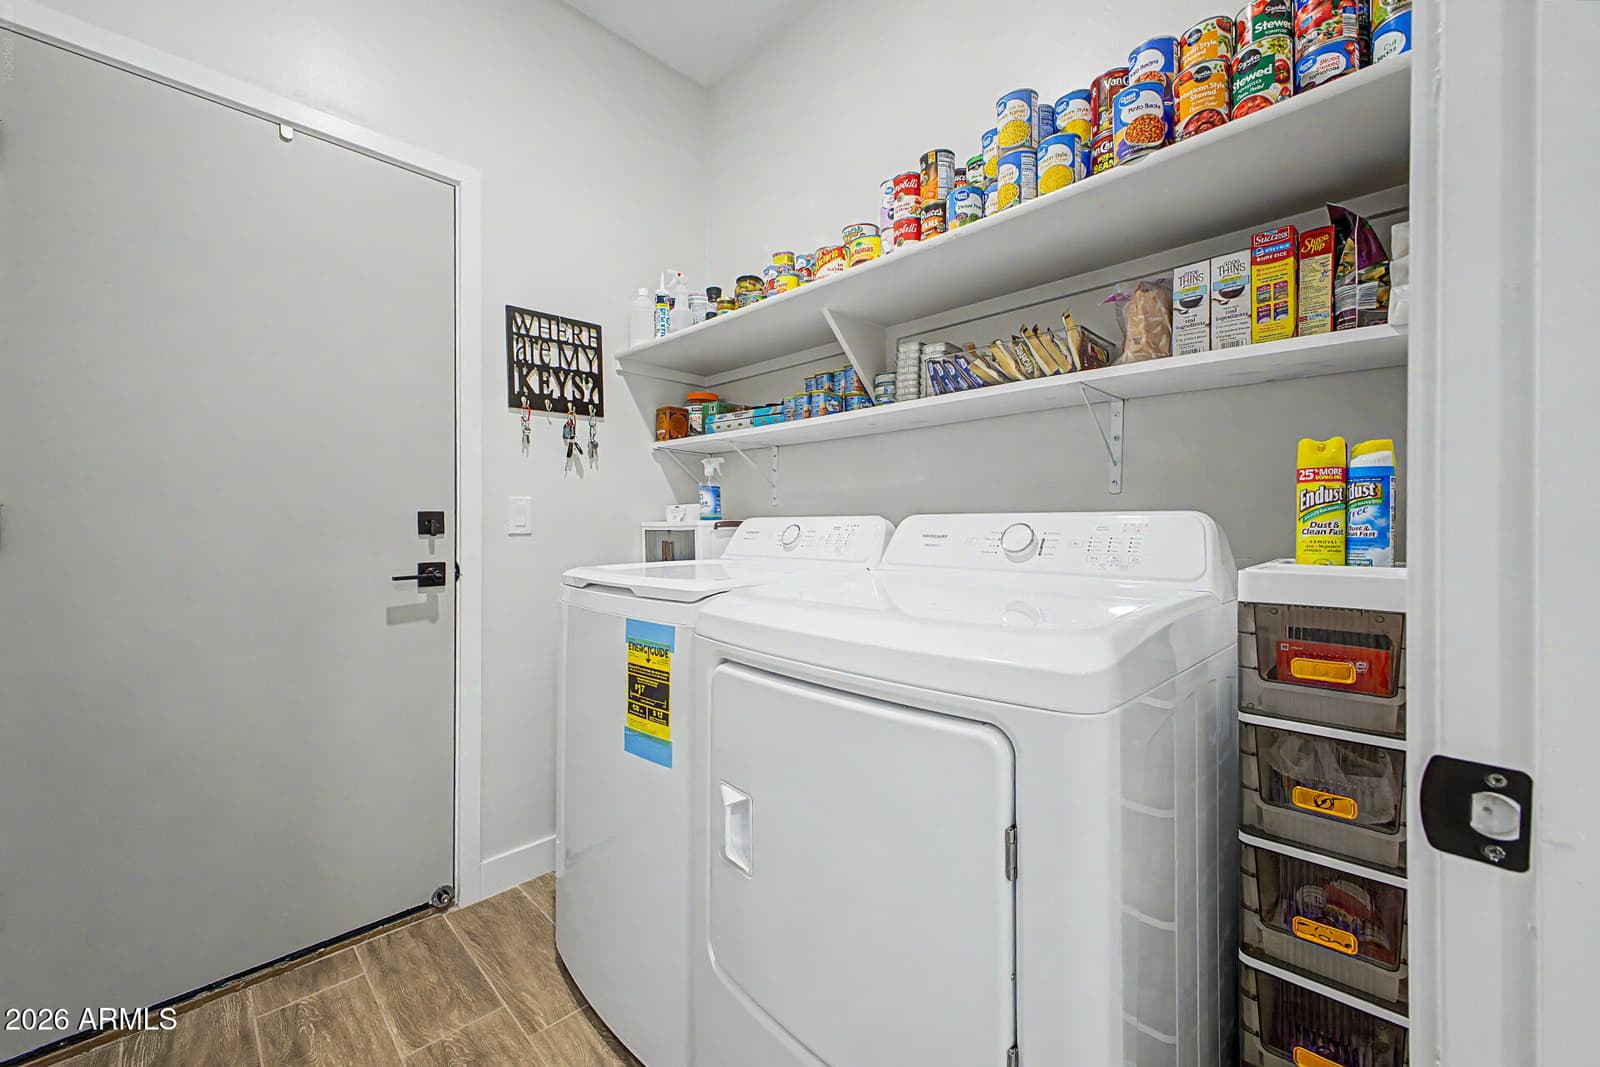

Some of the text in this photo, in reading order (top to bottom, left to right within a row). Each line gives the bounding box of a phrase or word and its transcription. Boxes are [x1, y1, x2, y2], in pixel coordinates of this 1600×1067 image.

[1104, 76, 1122, 89] Van
[1217, 262, 1246, 277] THINS
[1178, 272, 1204, 288] THINS
[513, 312, 599, 348] WHERE
[1348, 482, 1377, 500] dust
[1300, 485, 1345, 513] Endust
[1302, 528, 1327, 536] Clean
[1310, 521, 1340, 529] Dust &
